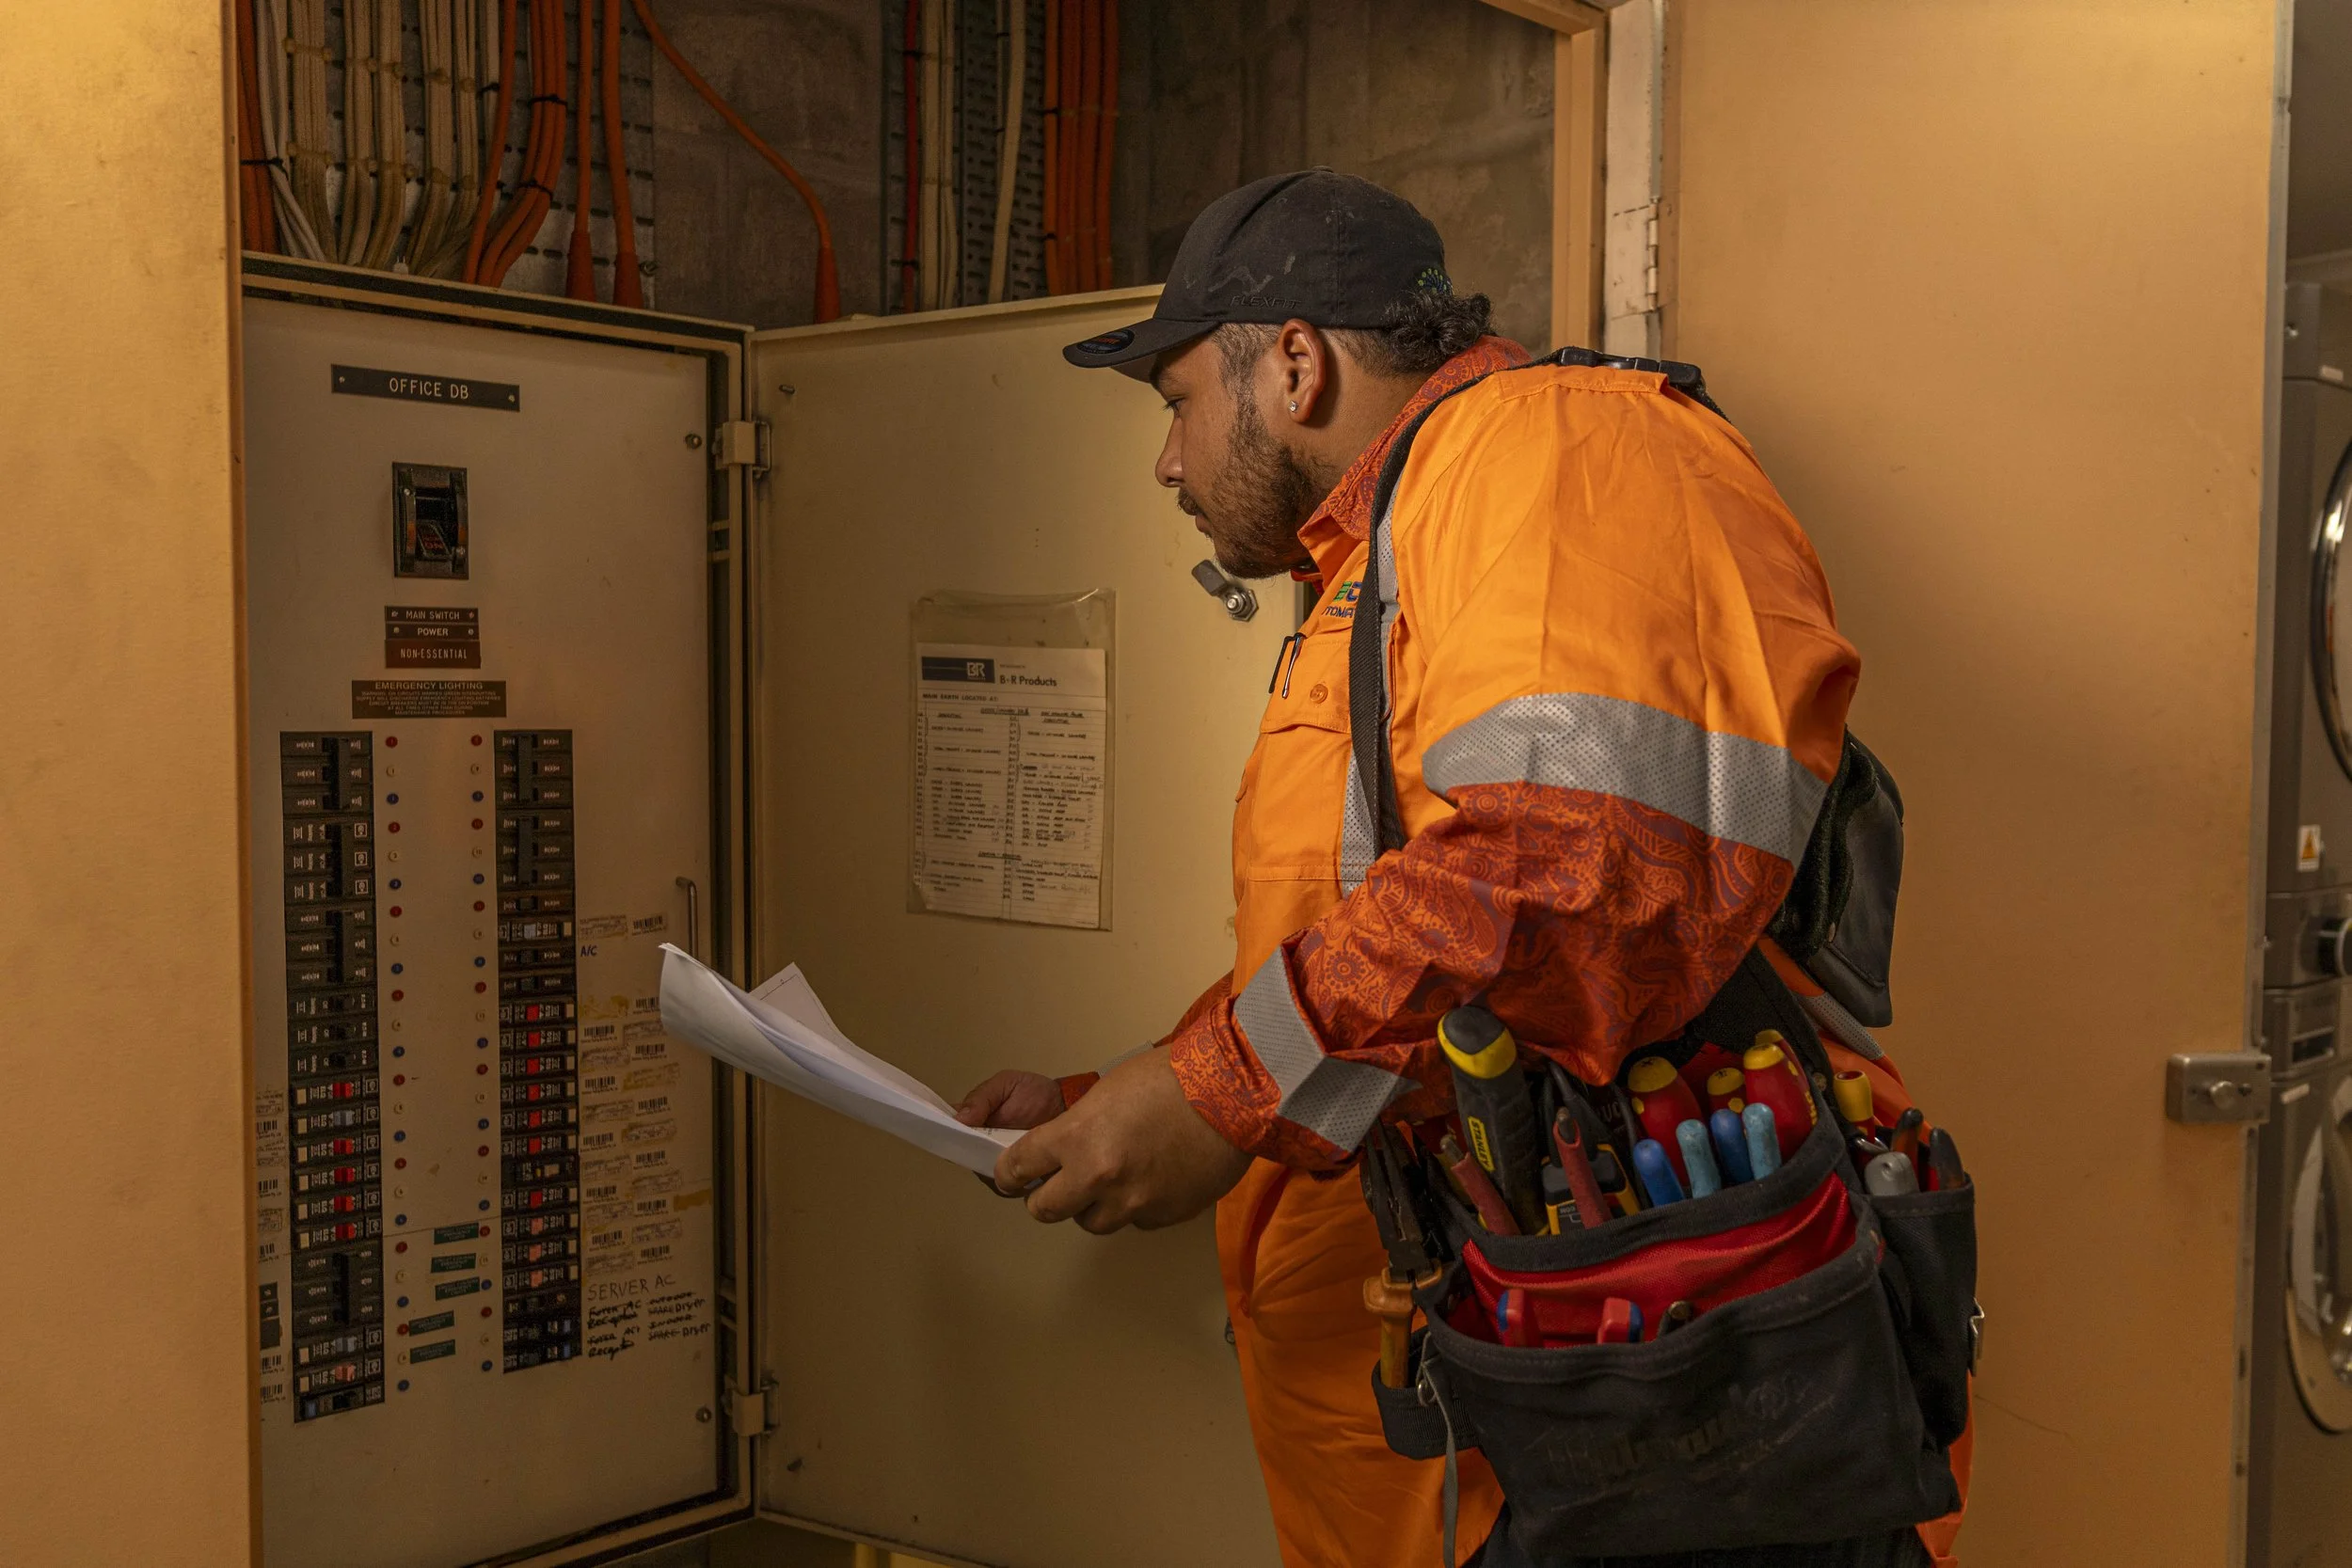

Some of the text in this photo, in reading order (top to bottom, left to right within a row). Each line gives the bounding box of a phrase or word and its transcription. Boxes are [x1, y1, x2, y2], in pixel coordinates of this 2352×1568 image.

[389, 377, 469, 400] OFFICE DB
[405, 610, 460, 621] MAIN SWITCH
[417, 627, 449, 637] POWER
[400, 648, 468, 659] NON-ESSENTIAL
[374, 681, 484, 690] EMERGENCY LIGHTING
[1019, 675, 1057, 687] Products
[580, 944, 599, 958] A/C
[587, 1274, 676, 1302] SERVER AC
